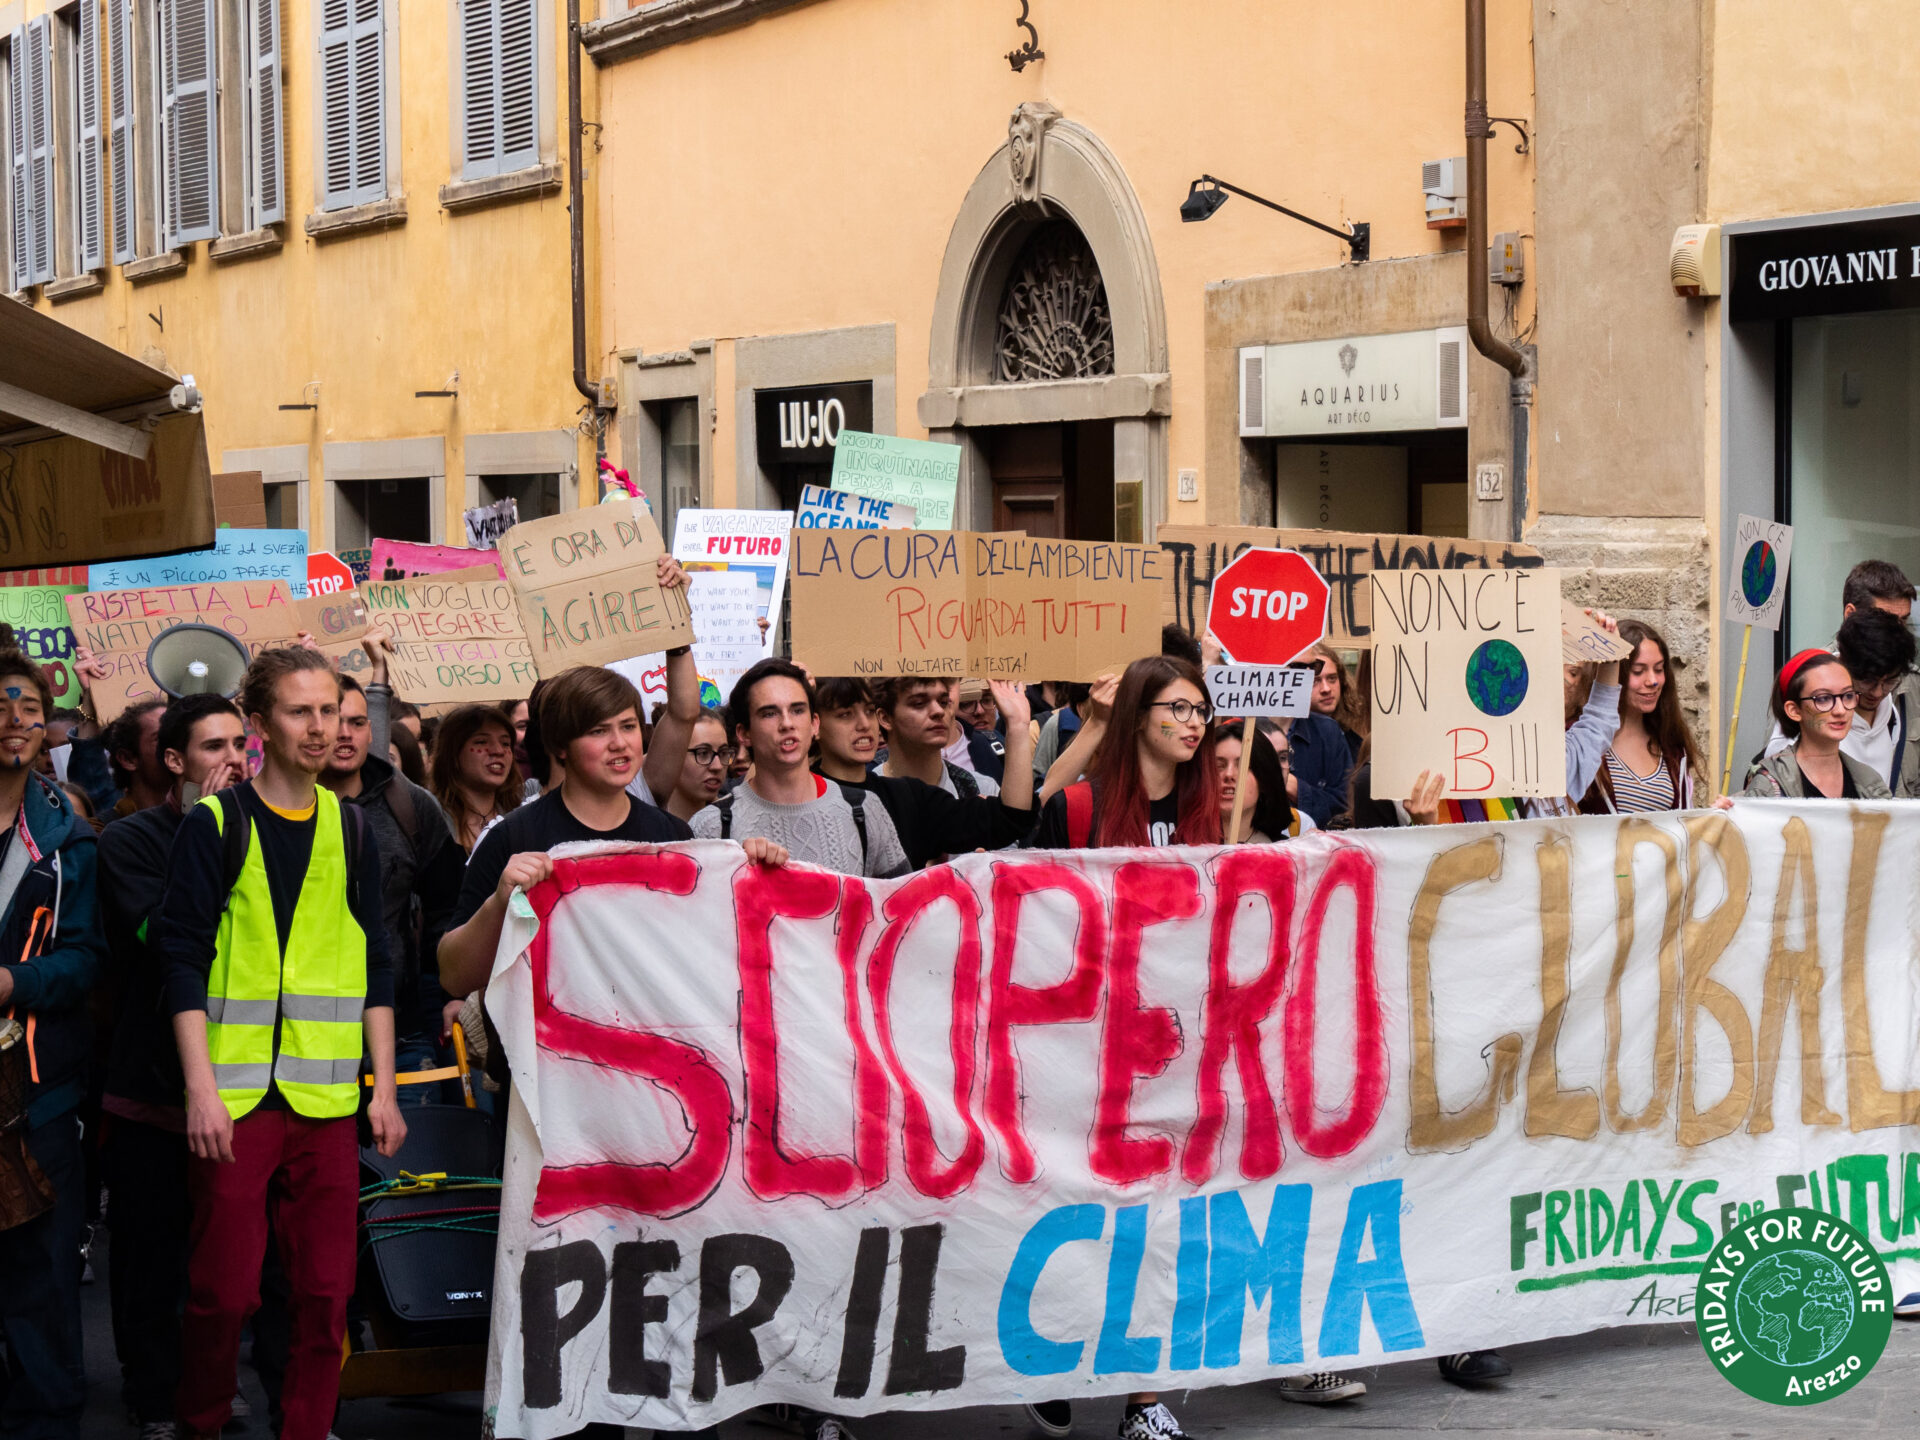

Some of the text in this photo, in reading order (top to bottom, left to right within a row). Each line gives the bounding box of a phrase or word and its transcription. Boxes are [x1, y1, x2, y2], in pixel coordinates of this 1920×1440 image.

[1759, 249, 1898, 291] GIOVANNI
[1301, 384, 1399, 405] AQUARIUS
[1328, 413, 1342, 424] ART
[842, 435, 884, 449] NON
[847, 450, 957, 481] INQUINARE
[838, 471, 923, 495] PENSA A
[1480, 471, 1499, 492] 132
[803, 486, 893, 520] LIKE THE
[684, 516, 789, 534] LE VACANZE
[1739, 520, 1760, 545] NON
[552, 529, 608, 567] ORA
[796, 534, 1164, 583] LA CURA DELL'AMBIENTE
[127, 571, 151, 584] UN
[233, 564, 292, 579] PAESE
[0, 590, 63, 624] URA
[83, 584, 288, 623] RISPETTA LA
[368, 584, 511, 611] NON VOGLIO
[1230, 587, 1308, 621] STOP
[374, 612, 514, 637] SPIEGARE
[886, 586, 1128, 653] RIGUARDA TUTTI
[437, 643, 498, 663] FIGLI
[854, 652, 1028, 674] NON VOLTARE LA TESTA!
[436, 664, 502, 688] ORSO
[1214, 671, 1305, 687] CLIMATE
[1373, 641, 1429, 716] UN
[1216, 690, 1295, 709] CHANGE
[531, 803, 1920, 1227] SCIOPERO GLOBAL
[1510, 1179, 1719, 1271] FRIDAYS
[445, 1291, 483, 1300] VONYX
[520, 1178, 1425, 1409] PER IL CLIMA
